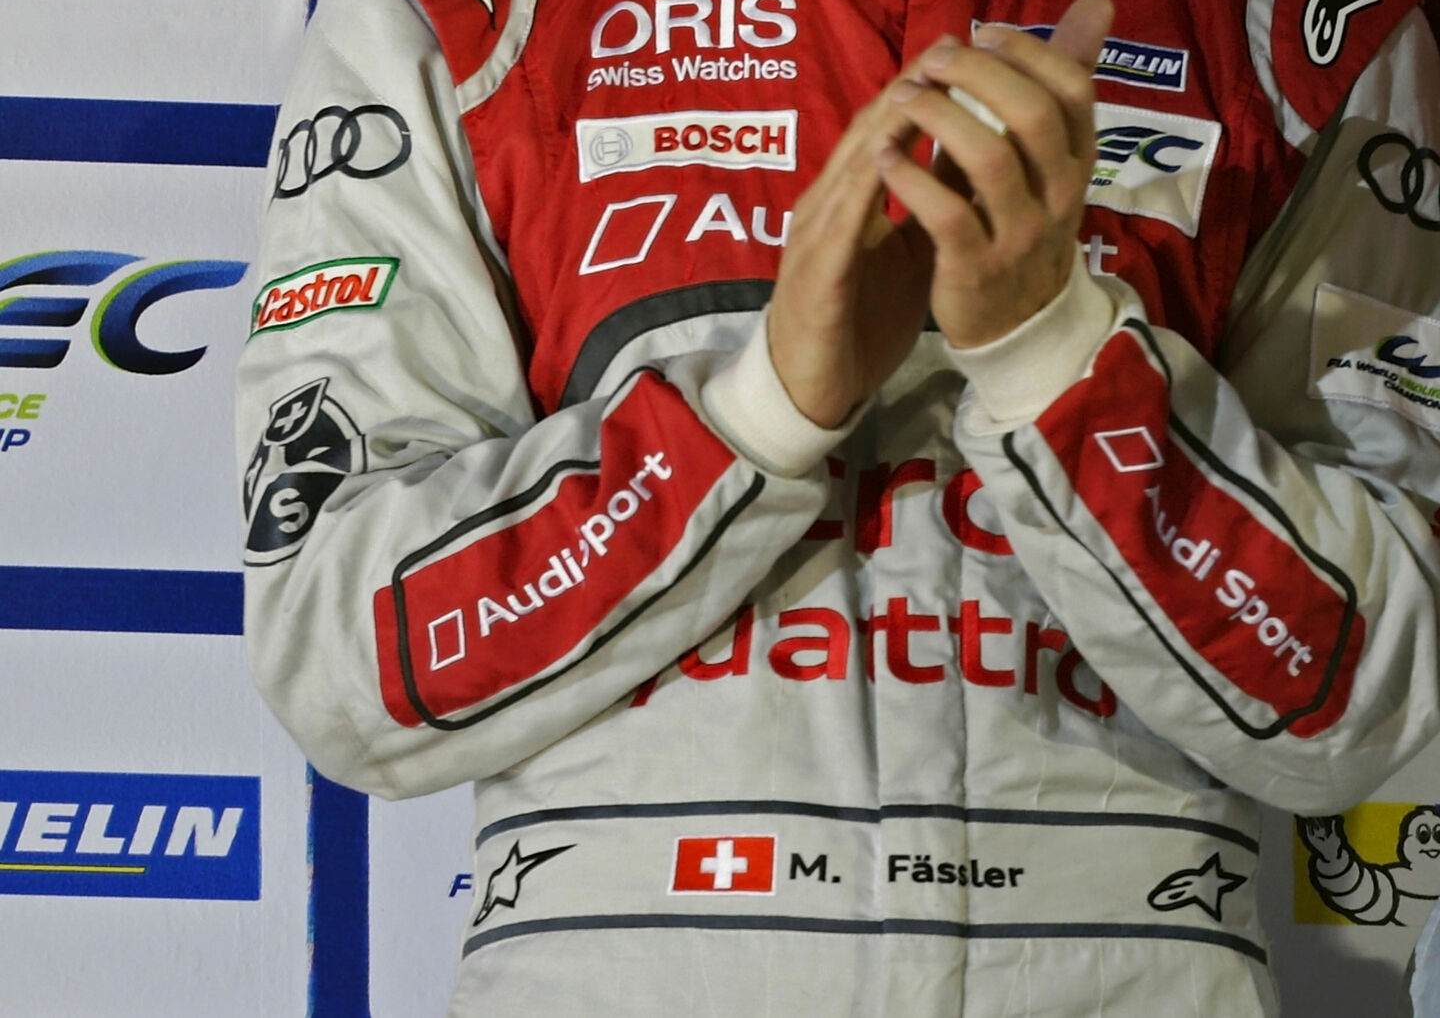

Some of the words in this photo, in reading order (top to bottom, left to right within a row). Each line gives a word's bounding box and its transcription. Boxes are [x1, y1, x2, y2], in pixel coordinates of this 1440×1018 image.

[586, 61, 665, 92] Swiss
[671, 53, 798, 82] Watches
[1097, 47, 1182, 77] HELIN
[654, 124, 787, 156] BOSCH
[685, 193, 793, 248] Au
[258, 267, 380, 329] Castrol
[477, 547, 586, 638] Audi
[1215, 568, 1313, 677] Sport
[629, 596, 1118, 719] uattro
[0, 802, 243, 858] ELIN
[789, 852, 842, 884] M.
[887, 854, 1025, 889] Fässler
